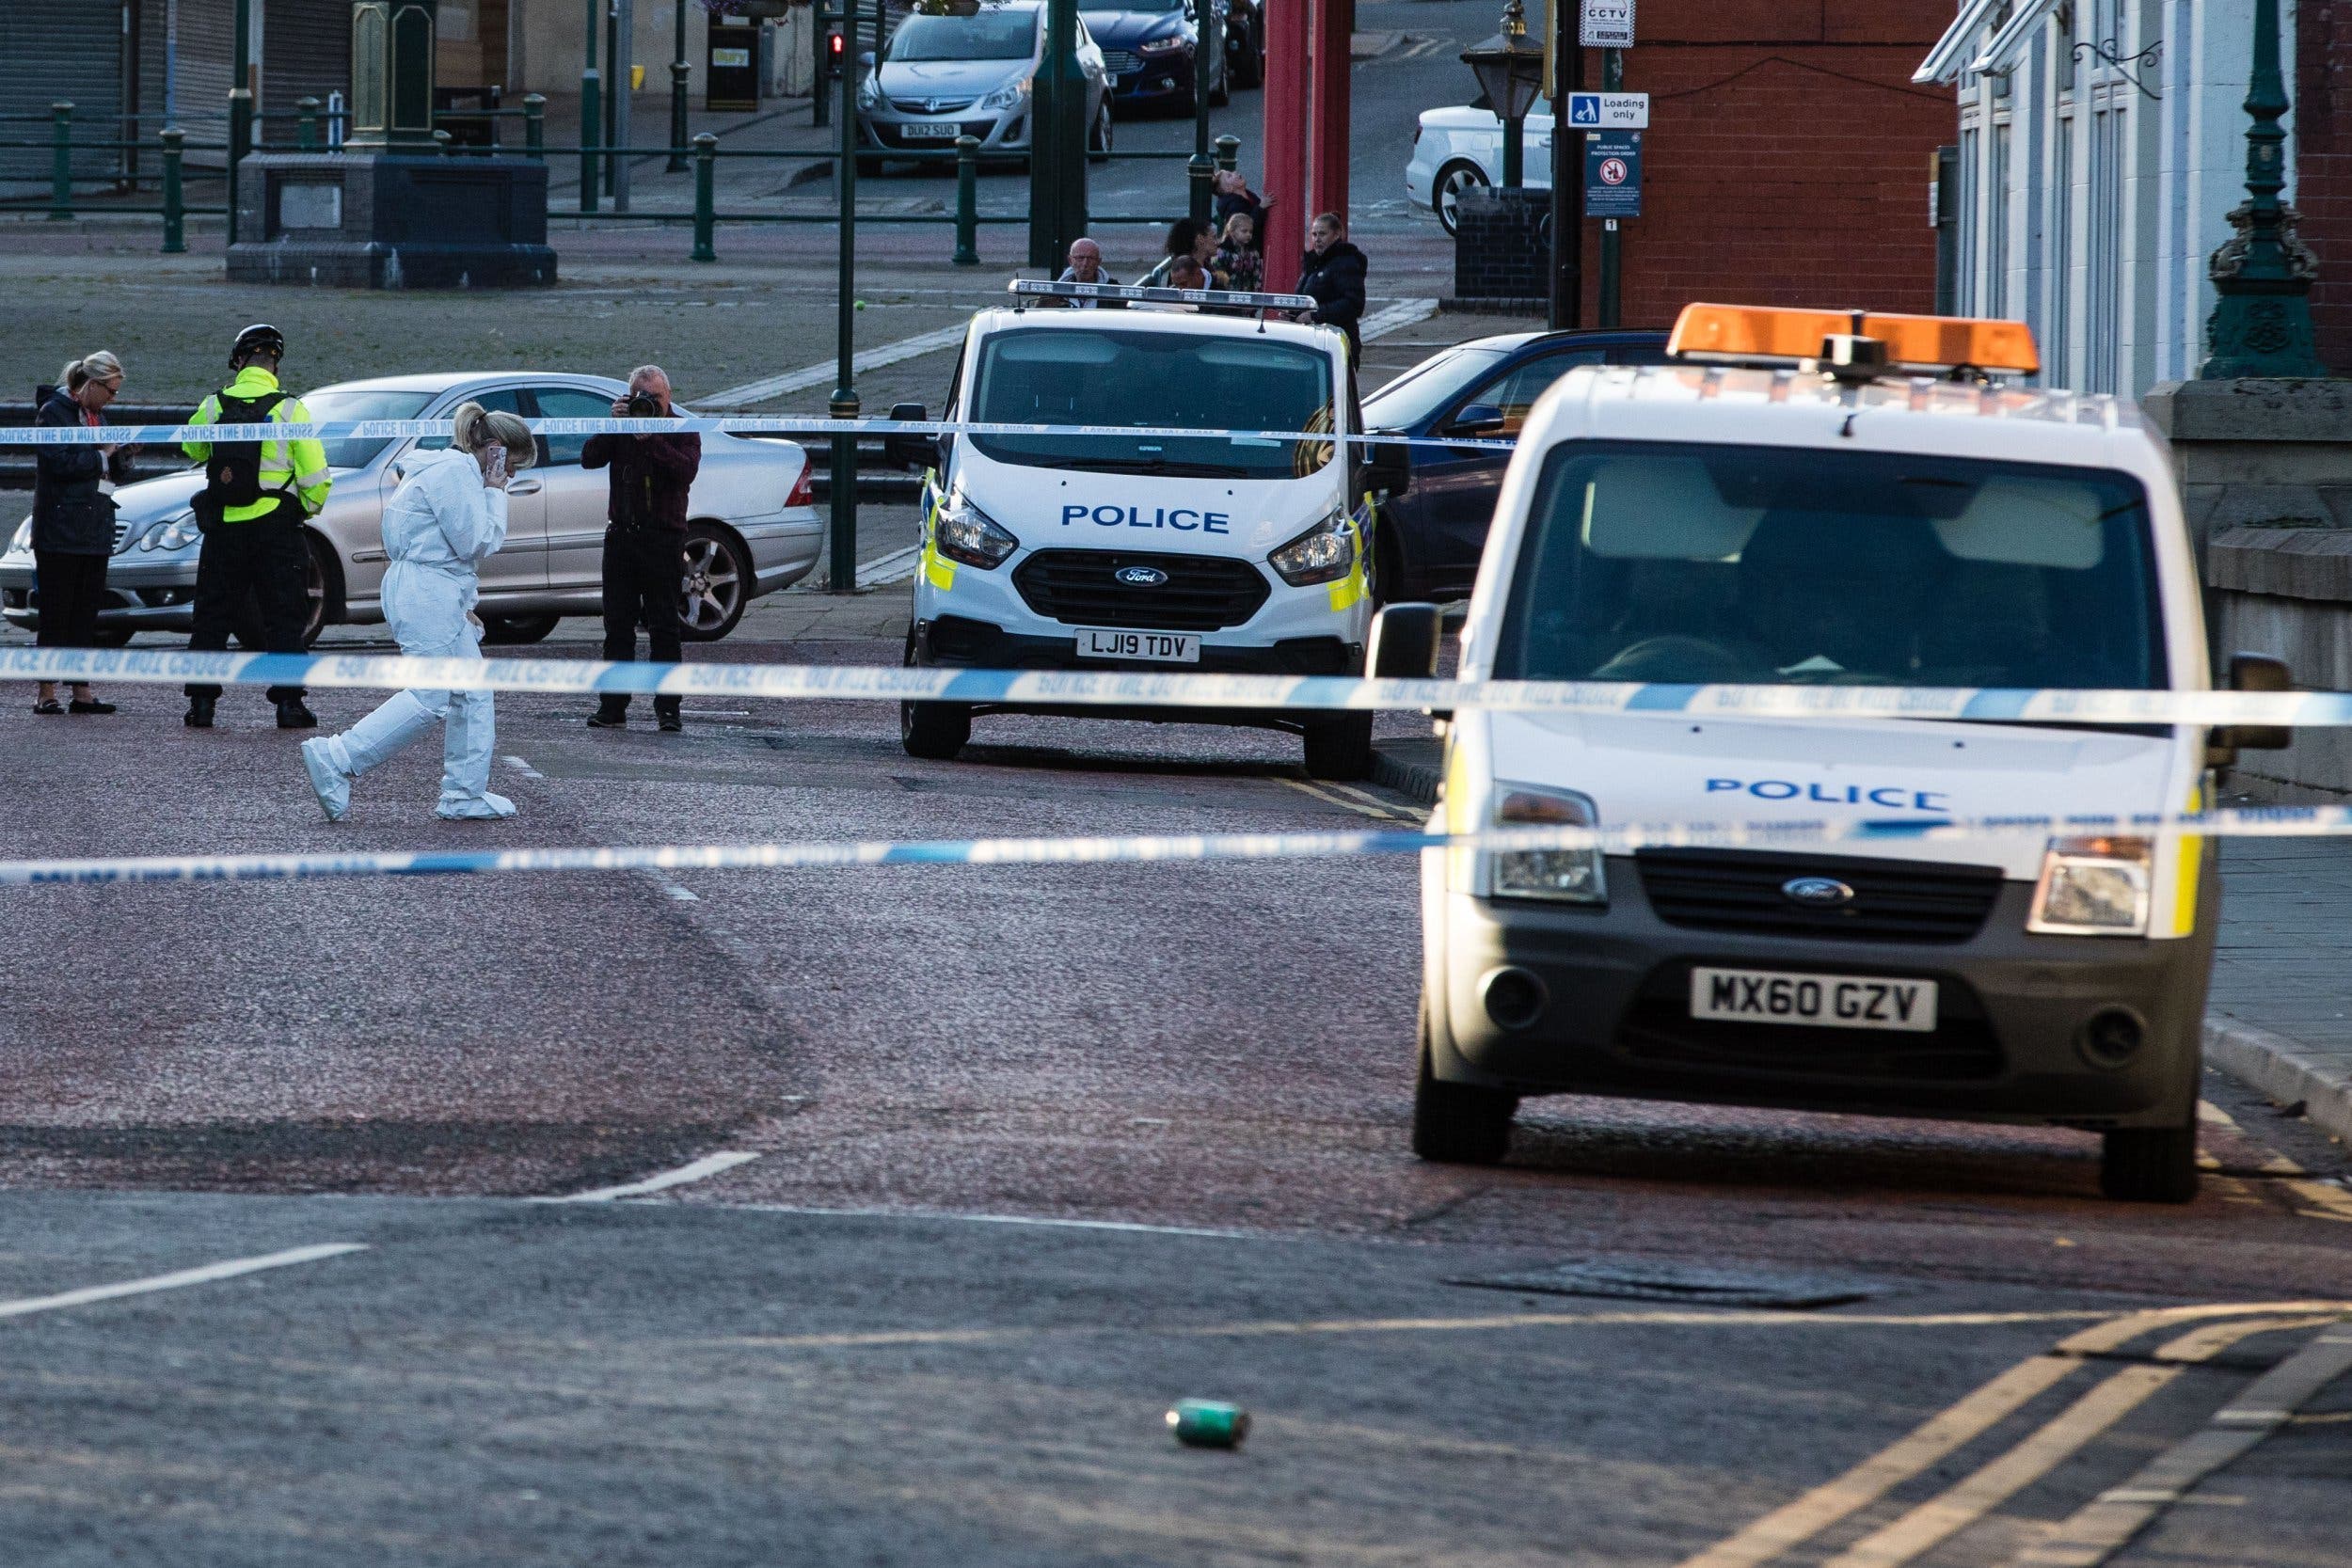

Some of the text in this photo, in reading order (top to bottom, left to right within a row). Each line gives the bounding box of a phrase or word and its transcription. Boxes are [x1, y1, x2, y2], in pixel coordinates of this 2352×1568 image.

[1588, 8, 1628, 19] CCTV
[1604, 99, 1645, 109] Loading
[1613, 110, 1635, 120] only
[1608, 220, 1614, 230] 1
[1062, 505, 1230, 535] POLICE
[1126, 568, 1156, 583] Ford
[1091, 633, 1186, 657] LJ19 TDV
[1706, 778, 1951, 812] POLICE
[1710, 975, 1918, 1022] MX60 GZV
